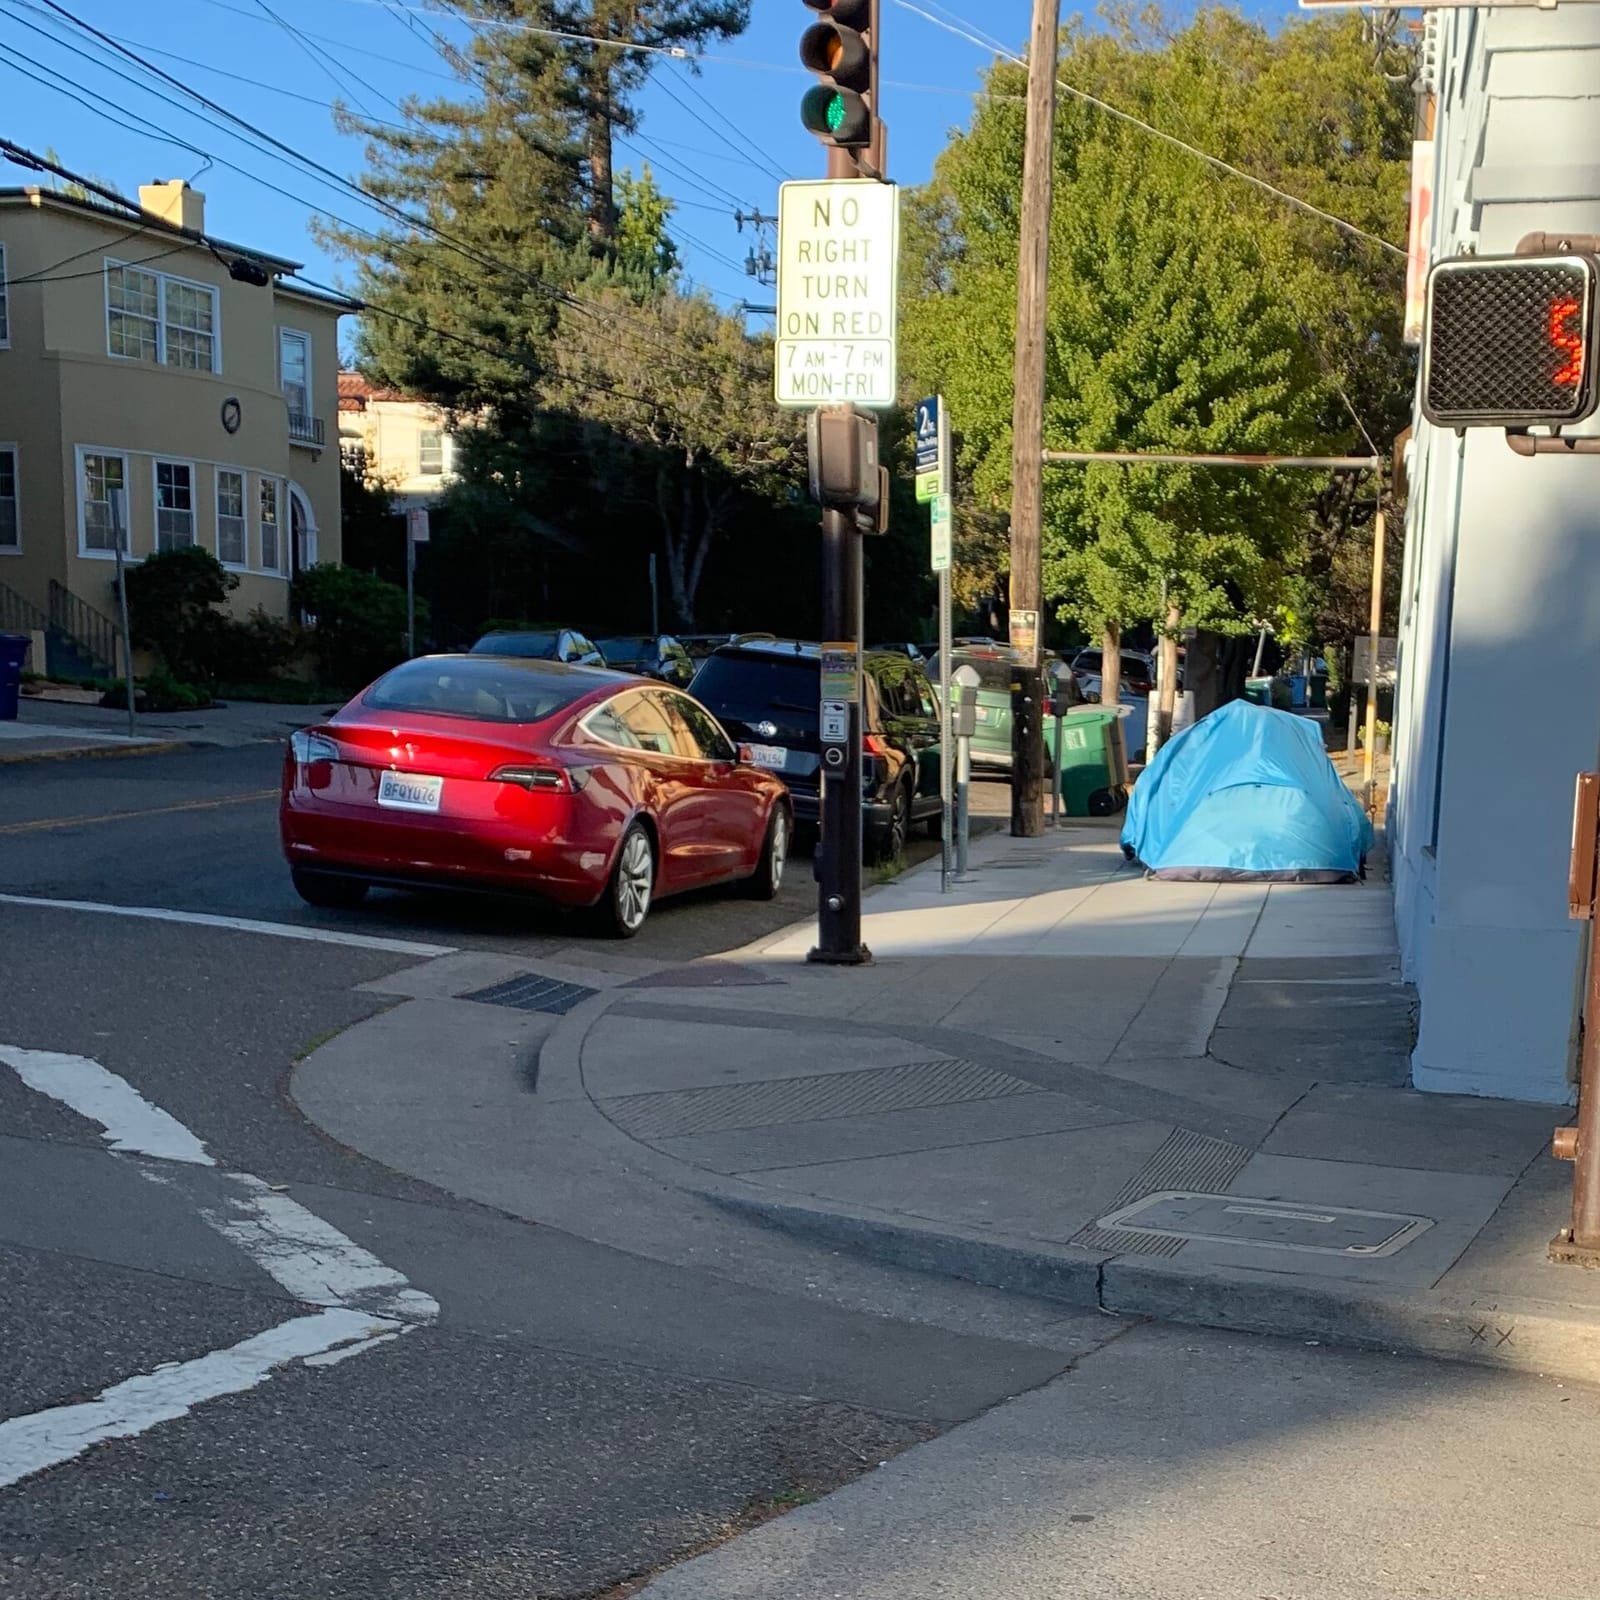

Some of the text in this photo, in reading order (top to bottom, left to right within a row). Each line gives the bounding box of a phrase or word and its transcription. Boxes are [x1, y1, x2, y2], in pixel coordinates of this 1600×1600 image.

[814, 198, 859, 228] NO
[798, 239, 872, 263] RIGHT
[802, 275, 868, 299] TURN
[787, 311, 883, 335] ON RED
[1552, 301, 1583, 385] 5
[786, 345, 797, 368] 7
[863, 353, 883, 367] PM
[791, 372, 874, 396] MON-FRI
